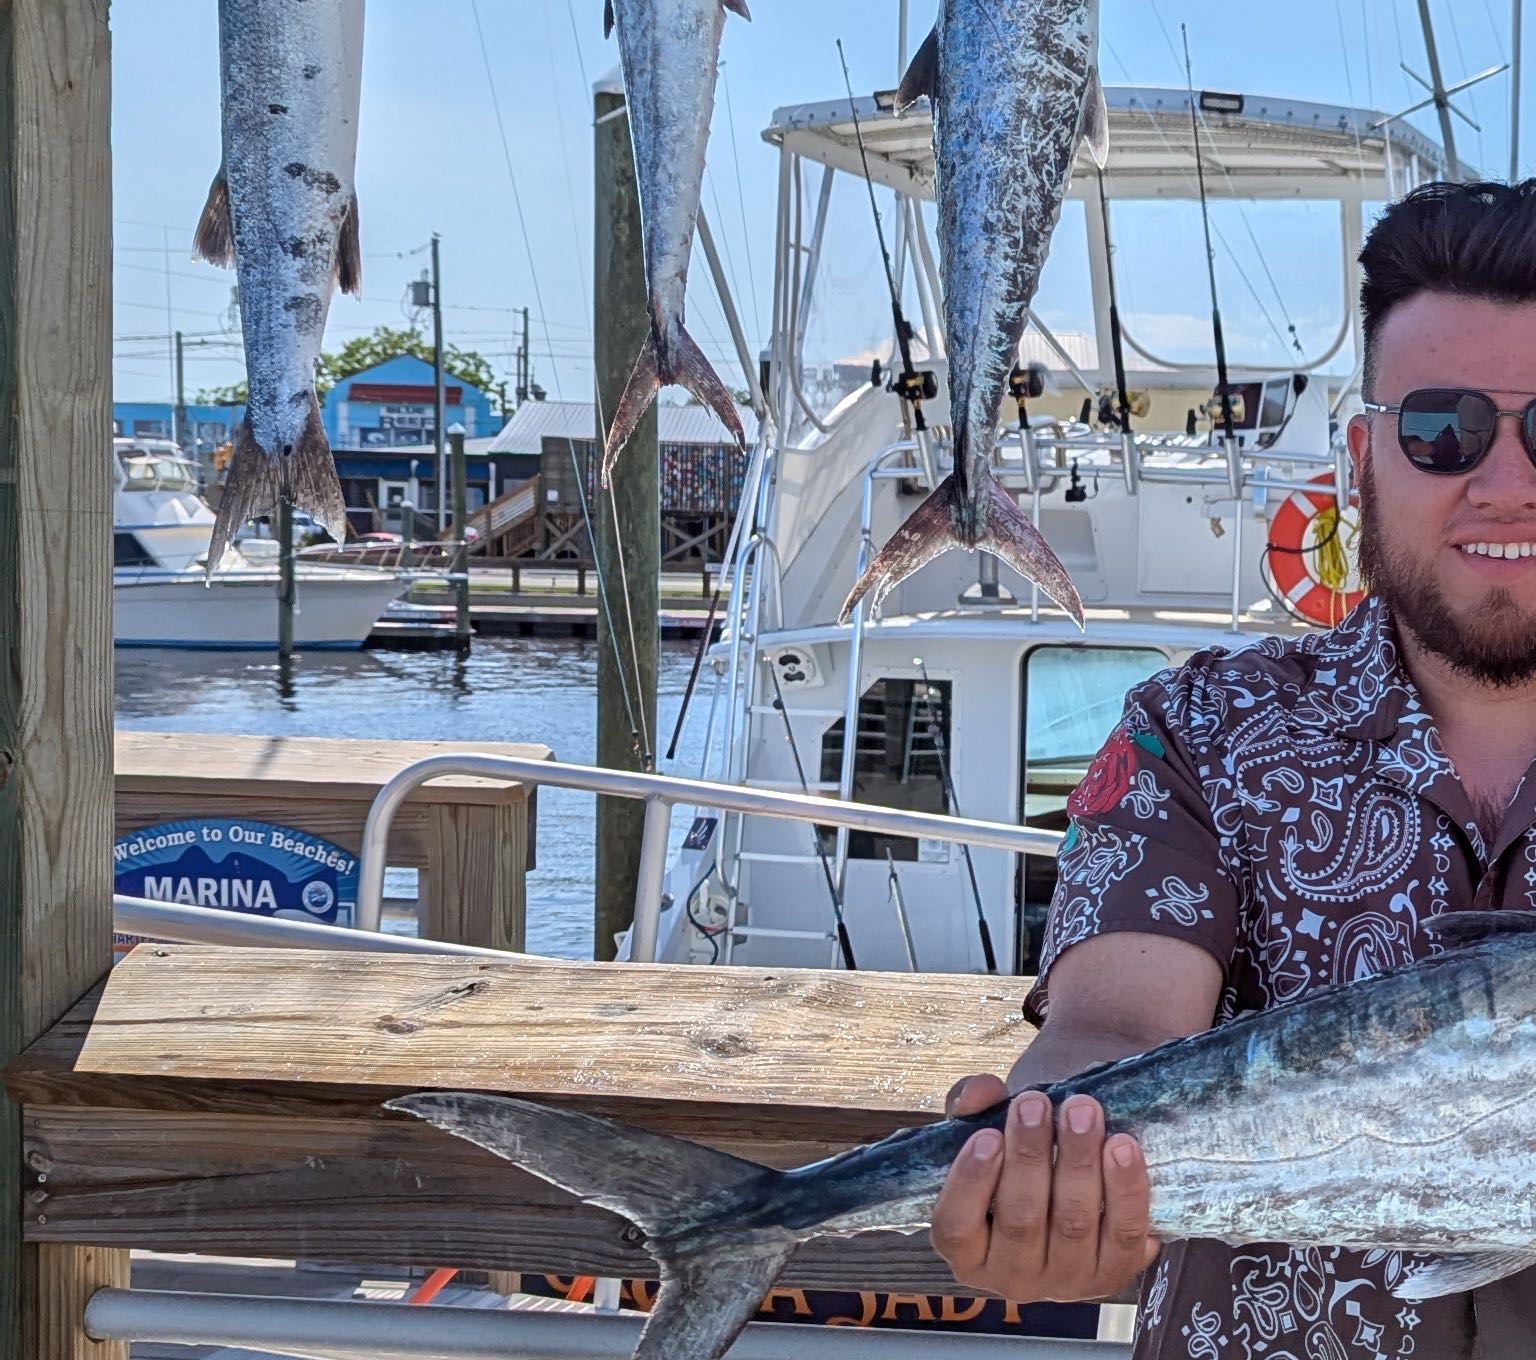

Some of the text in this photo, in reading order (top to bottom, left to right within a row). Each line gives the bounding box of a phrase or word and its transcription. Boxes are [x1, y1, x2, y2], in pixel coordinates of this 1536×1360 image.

[201, 826, 222, 842] to
[229, 825, 265, 845] Our
[270, 831, 356, 876] Beaches!
[144, 876, 278, 909] MARINA
